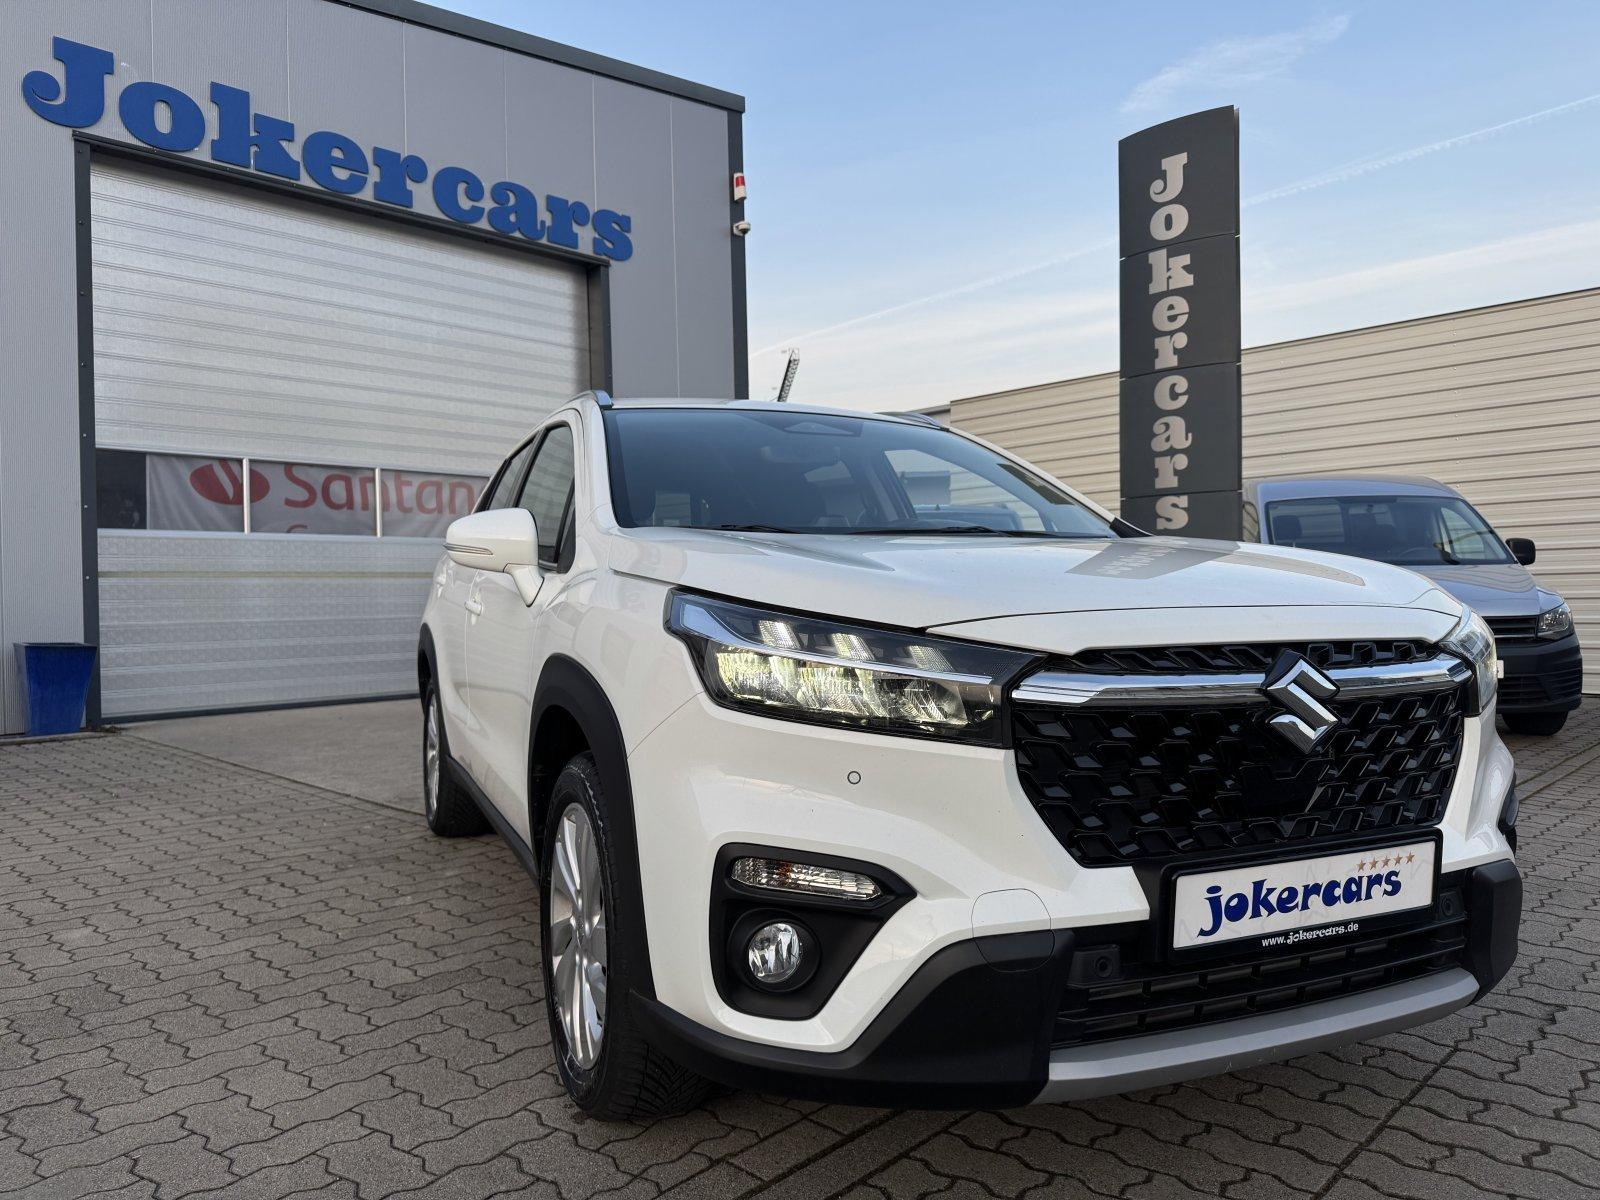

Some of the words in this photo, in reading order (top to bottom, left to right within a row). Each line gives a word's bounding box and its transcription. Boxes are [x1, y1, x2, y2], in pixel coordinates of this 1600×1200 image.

[23, 37, 633, 261] Jokercars
[1149, 152, 1194, 530] Jokercars
[1197, 870, 1402, 937] jokercars
[1261, 922, 1359, 947] www.jokercars.de
